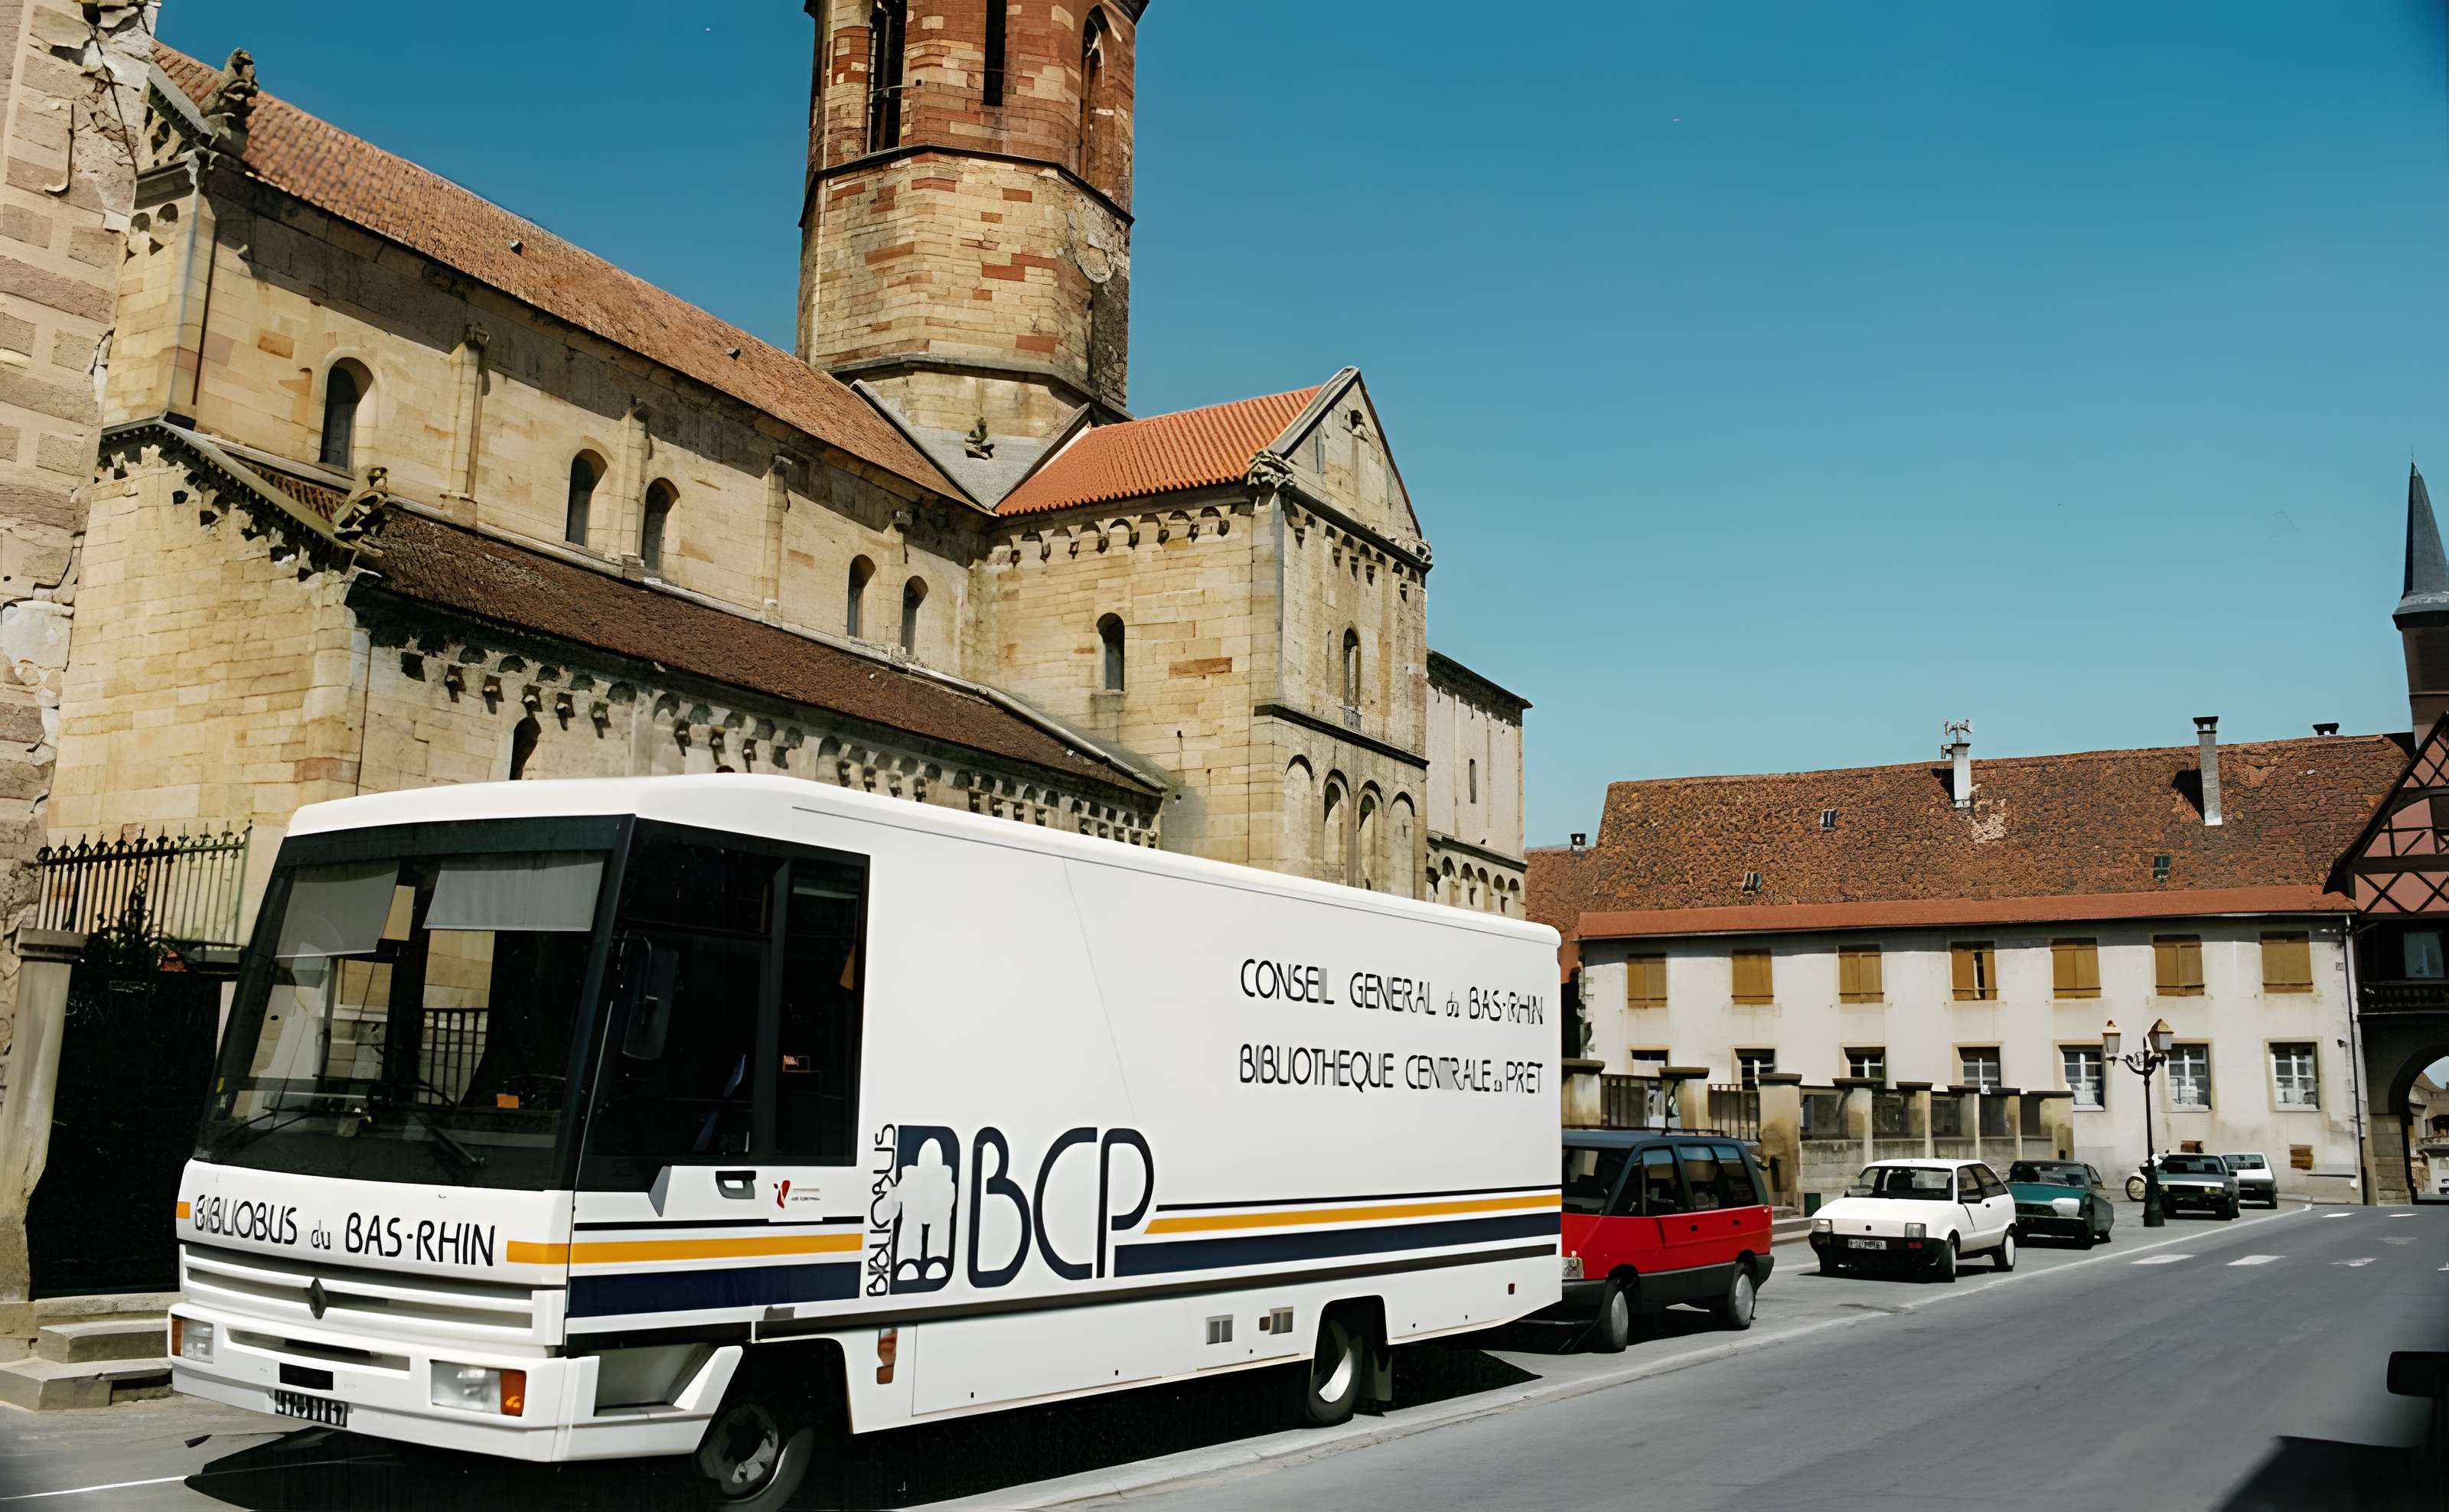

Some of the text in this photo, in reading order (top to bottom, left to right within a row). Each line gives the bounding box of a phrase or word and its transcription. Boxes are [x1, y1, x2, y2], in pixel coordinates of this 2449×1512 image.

[1349, 972, 1436, 1015] GENERAL
[1240, 1043, 1394, 1093] BIBLIOTHEQUE
[194, 1194, 298, 1246] BIBLIOBUS
[310, 1219, 331, 1250] du
[967, 1126, 1155, 1289] BCP
